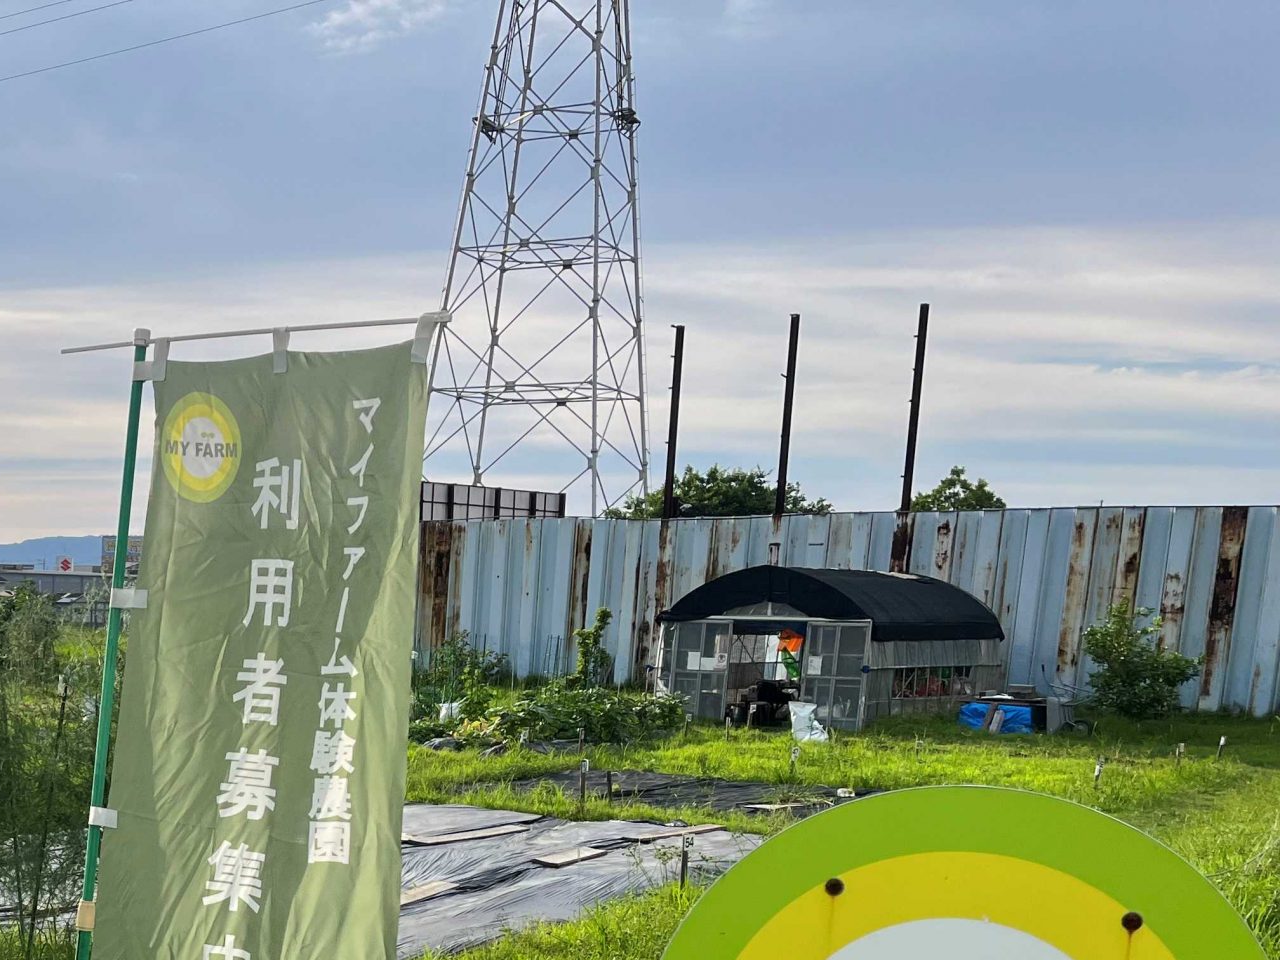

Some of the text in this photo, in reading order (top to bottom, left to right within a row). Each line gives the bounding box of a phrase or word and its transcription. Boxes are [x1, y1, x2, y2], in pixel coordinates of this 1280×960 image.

[165, 439, 238, 458] MY FARM
[308, 398, 381, 864] マイファーム体験農園
[685, 837, 694, 848] 54
